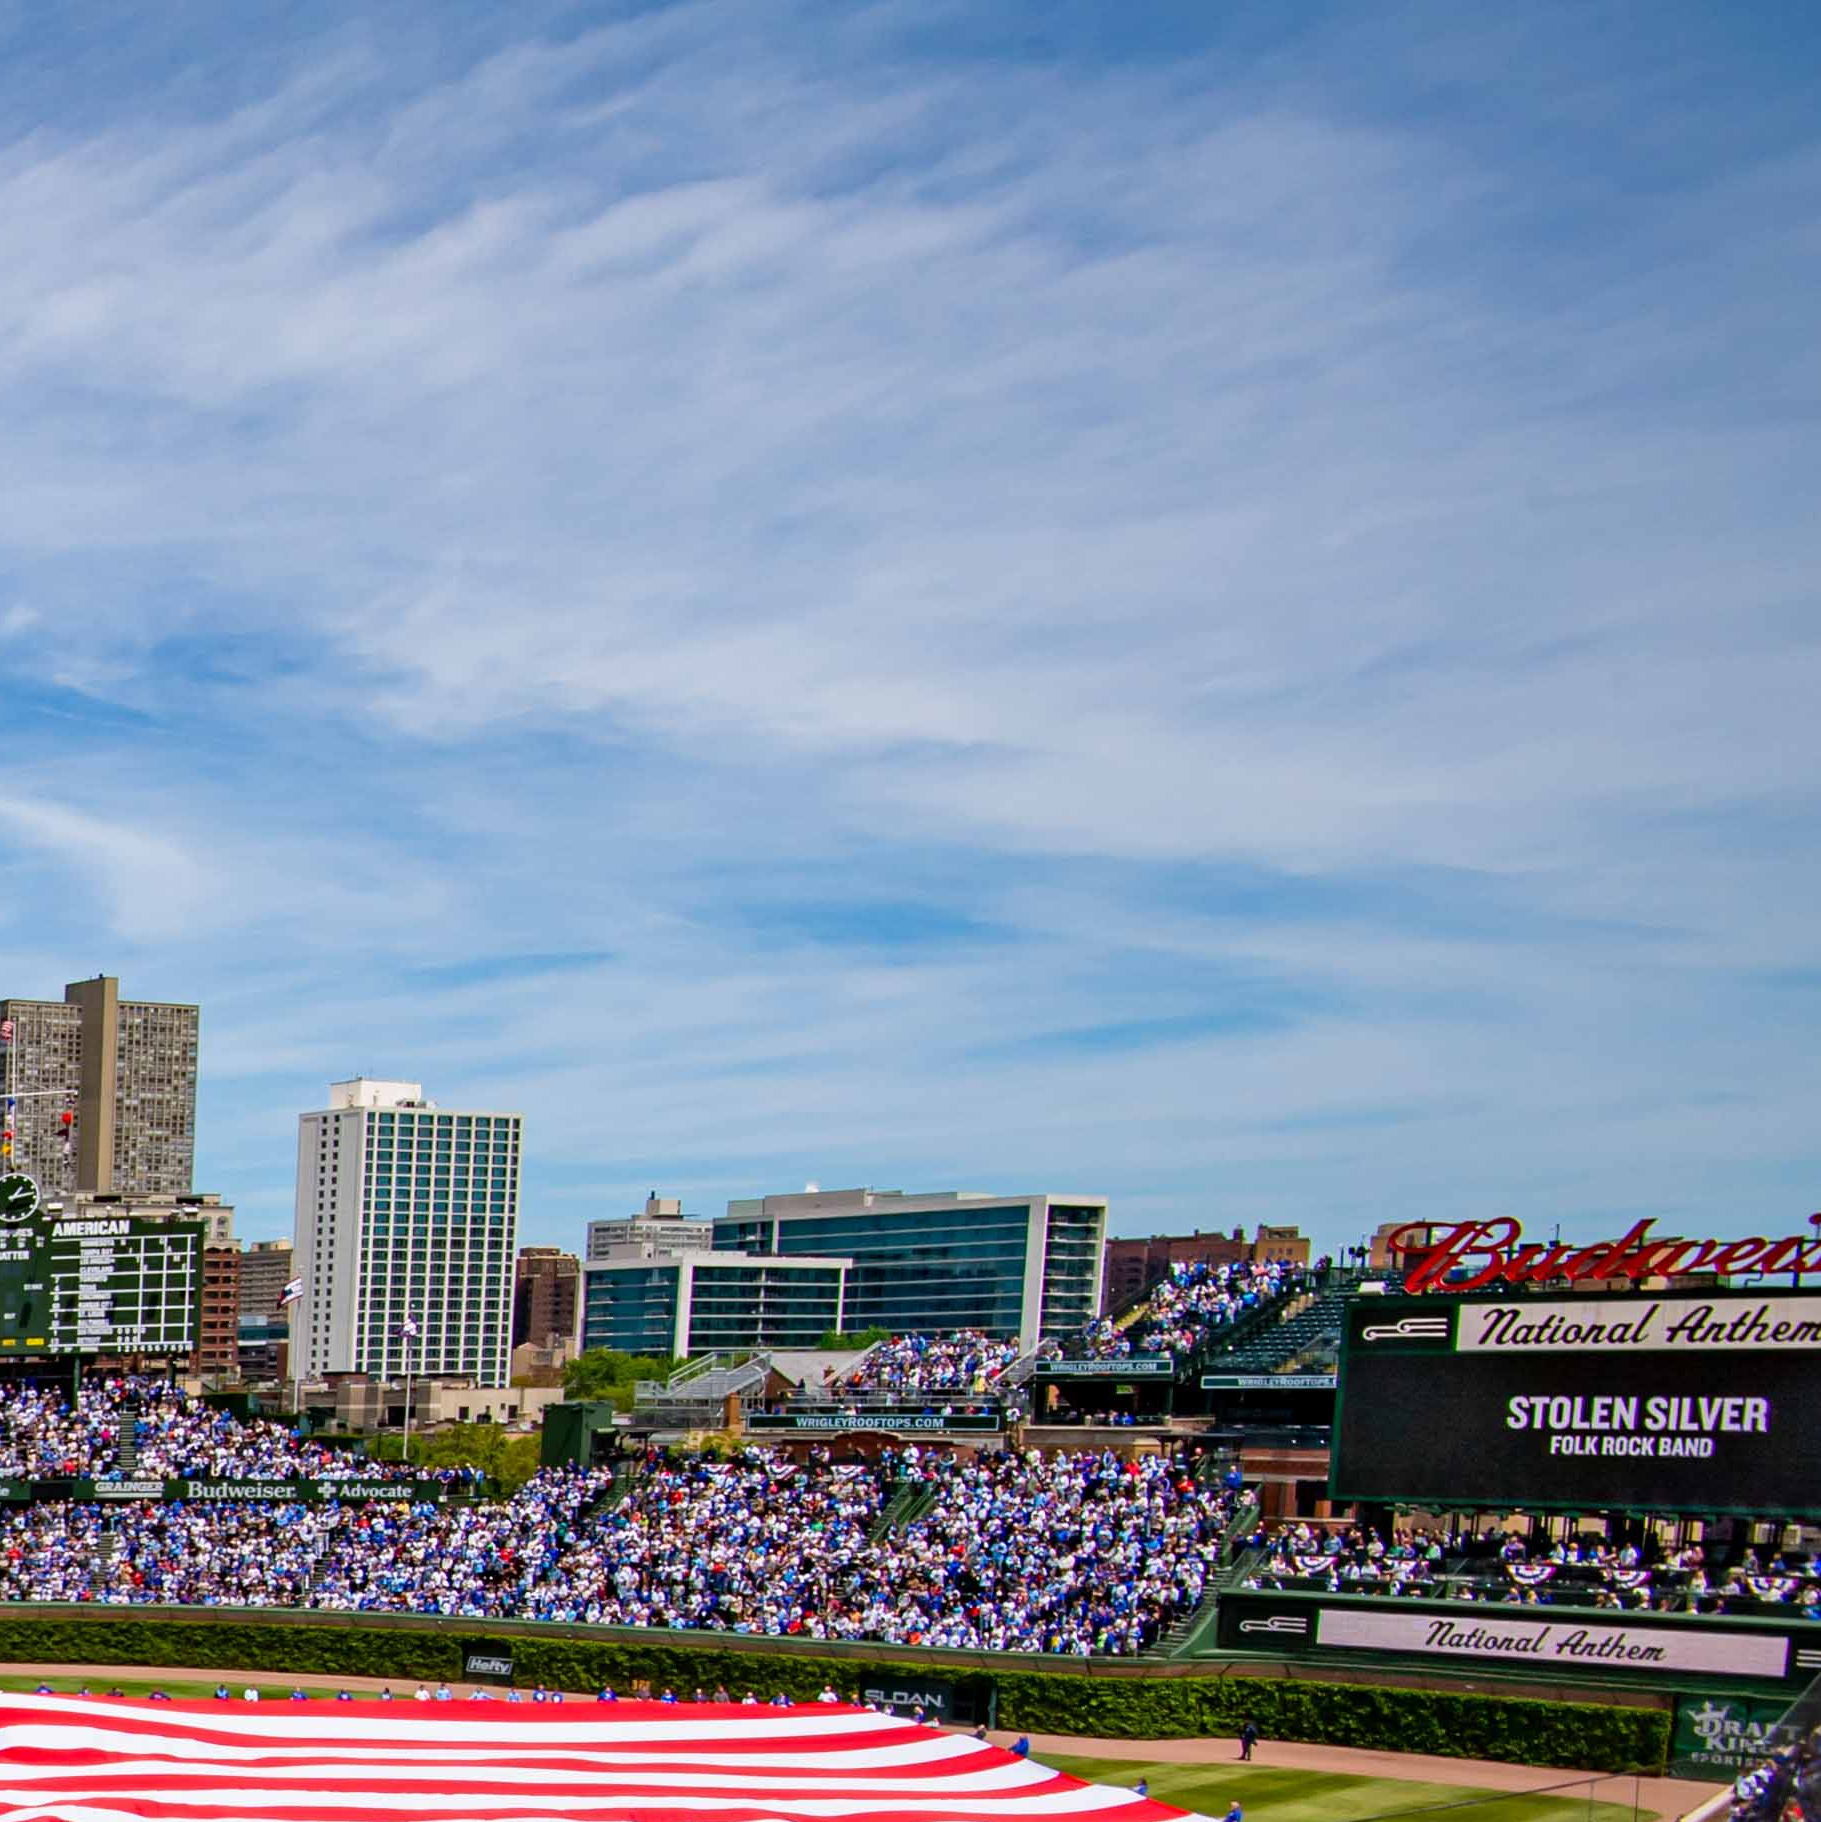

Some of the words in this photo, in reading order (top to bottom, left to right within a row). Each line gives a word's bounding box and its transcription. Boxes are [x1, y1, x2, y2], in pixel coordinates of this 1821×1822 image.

[52, 1219, 130, 1236] AMERICAN
[1478, 1303, 1660, 1345] National
[796, 1416, 944, 1429] WRIGLEYROOFTOPS.COM
[1506, 1396, 1638, 1431] STOLEN
[1645, 1397, 1772, 1433] SILVER
[1550, 1435, 1598, 1455] FOLK
[1601, 1436, 1654, 1456] ROCK
[1659, 1436, 1715, 1458] BAND
[339, 1483, 412, 1498] Advocate
[1425, 1620, 1552, 1654] National
[1556, 1630, 1667, 1662] Anthem
[470, 1659, 510, 1674] Hefty
[864, 1689, 943, 1707] SLOAN
